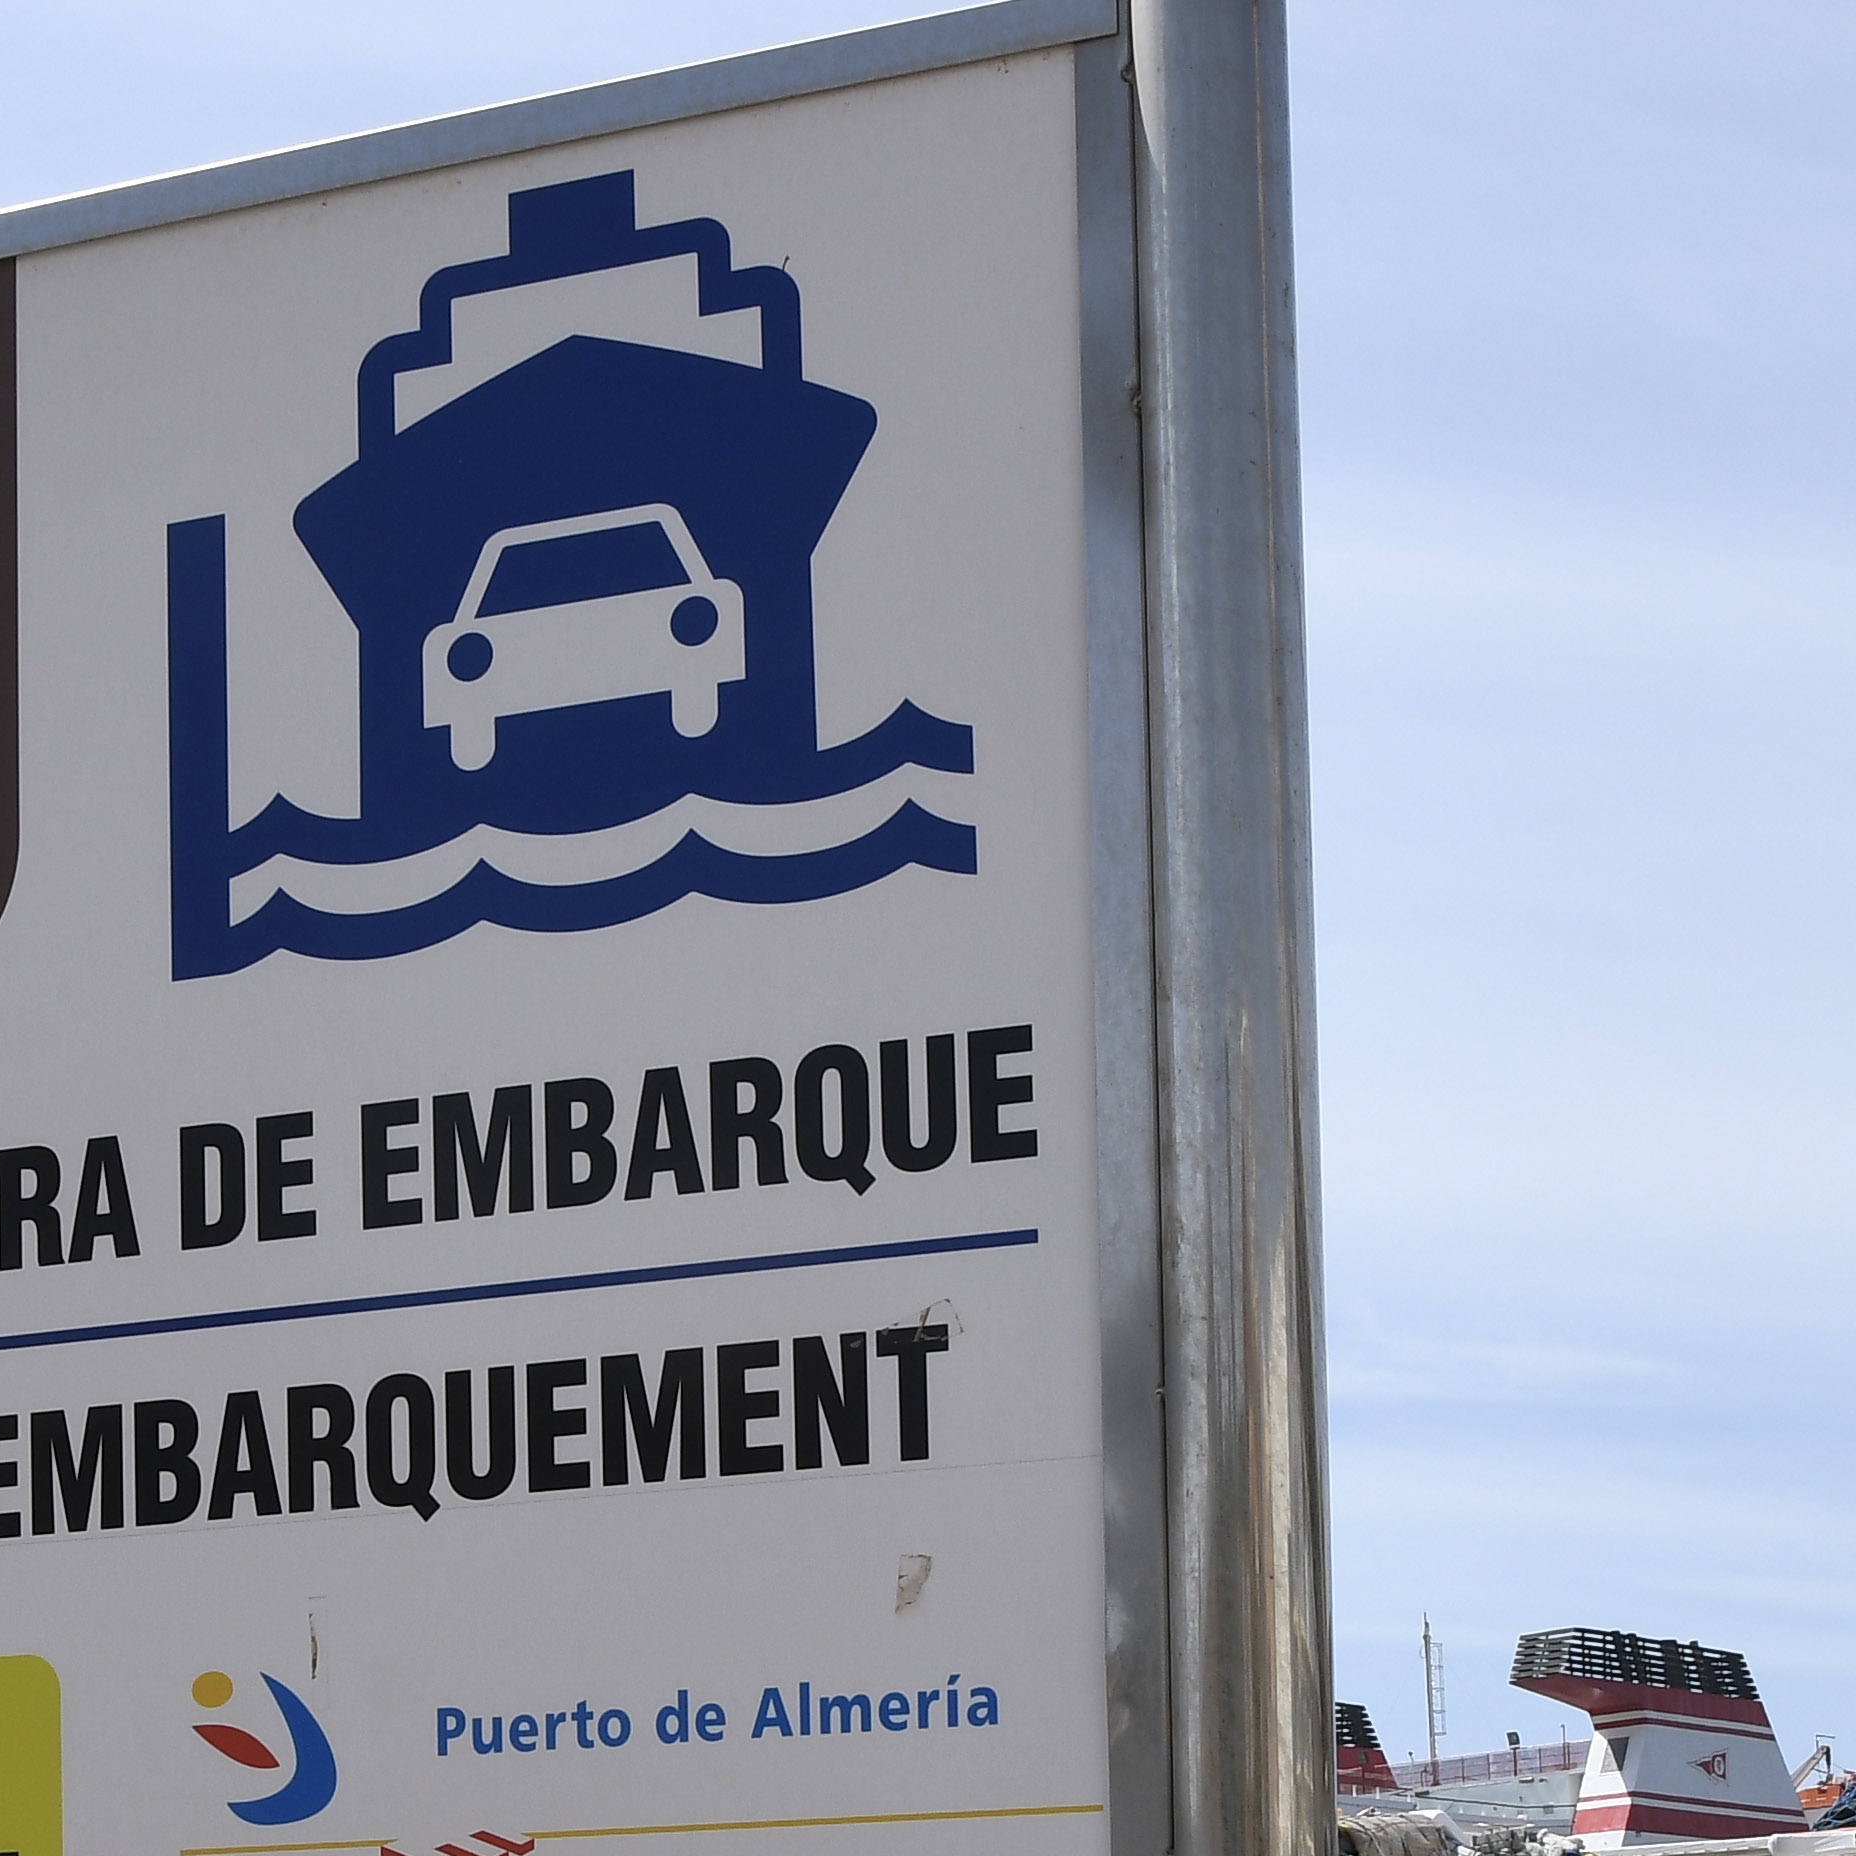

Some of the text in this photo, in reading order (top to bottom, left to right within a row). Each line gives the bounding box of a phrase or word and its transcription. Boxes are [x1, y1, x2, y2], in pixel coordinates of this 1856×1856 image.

[180, 1111, 317, 1252] DE
[361, 1024, 1039, 1231] EMBARQUE
[436, 1674, 1001, 1757] Puerto de Almería
